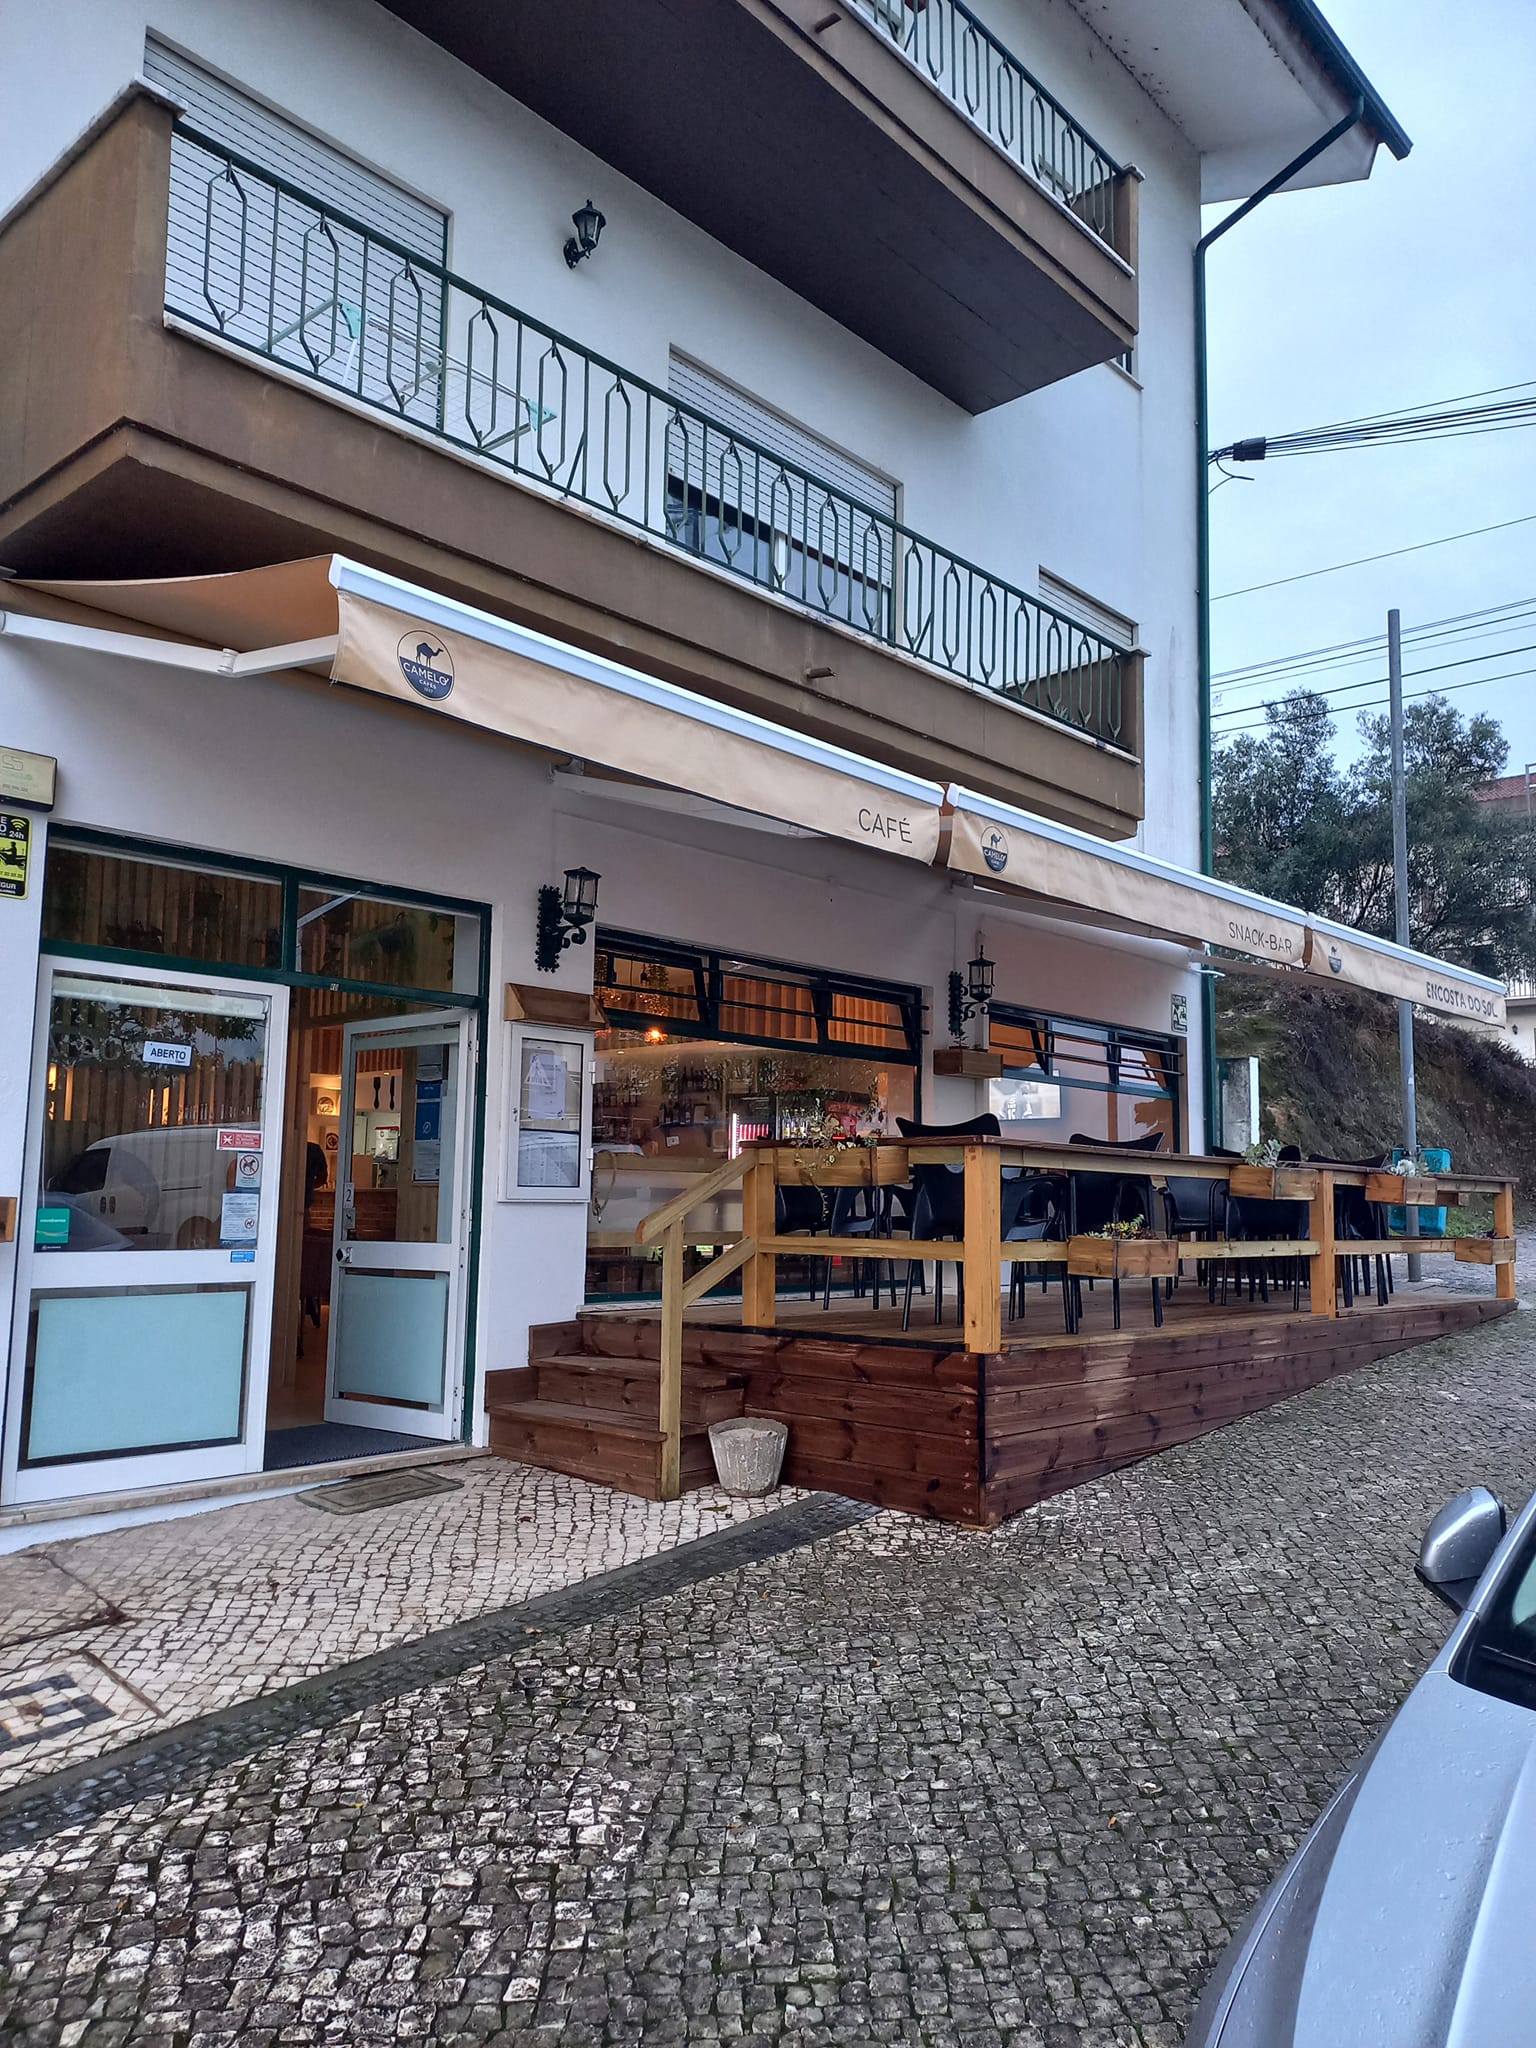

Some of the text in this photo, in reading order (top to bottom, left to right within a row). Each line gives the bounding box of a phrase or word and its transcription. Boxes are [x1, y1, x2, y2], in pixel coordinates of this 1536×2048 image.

[403, 662, 449, 686] CAMELO
[9, 830, 25, 839] 24h
[858, 808, 912, 844] CAFÉ
[1228, 922, 1292, 955] SNACK-BAR
[1426, 981, 1498, 1018] ENCOSTA DO SOL
[150, 1047, 187, 1060] ABERTO
